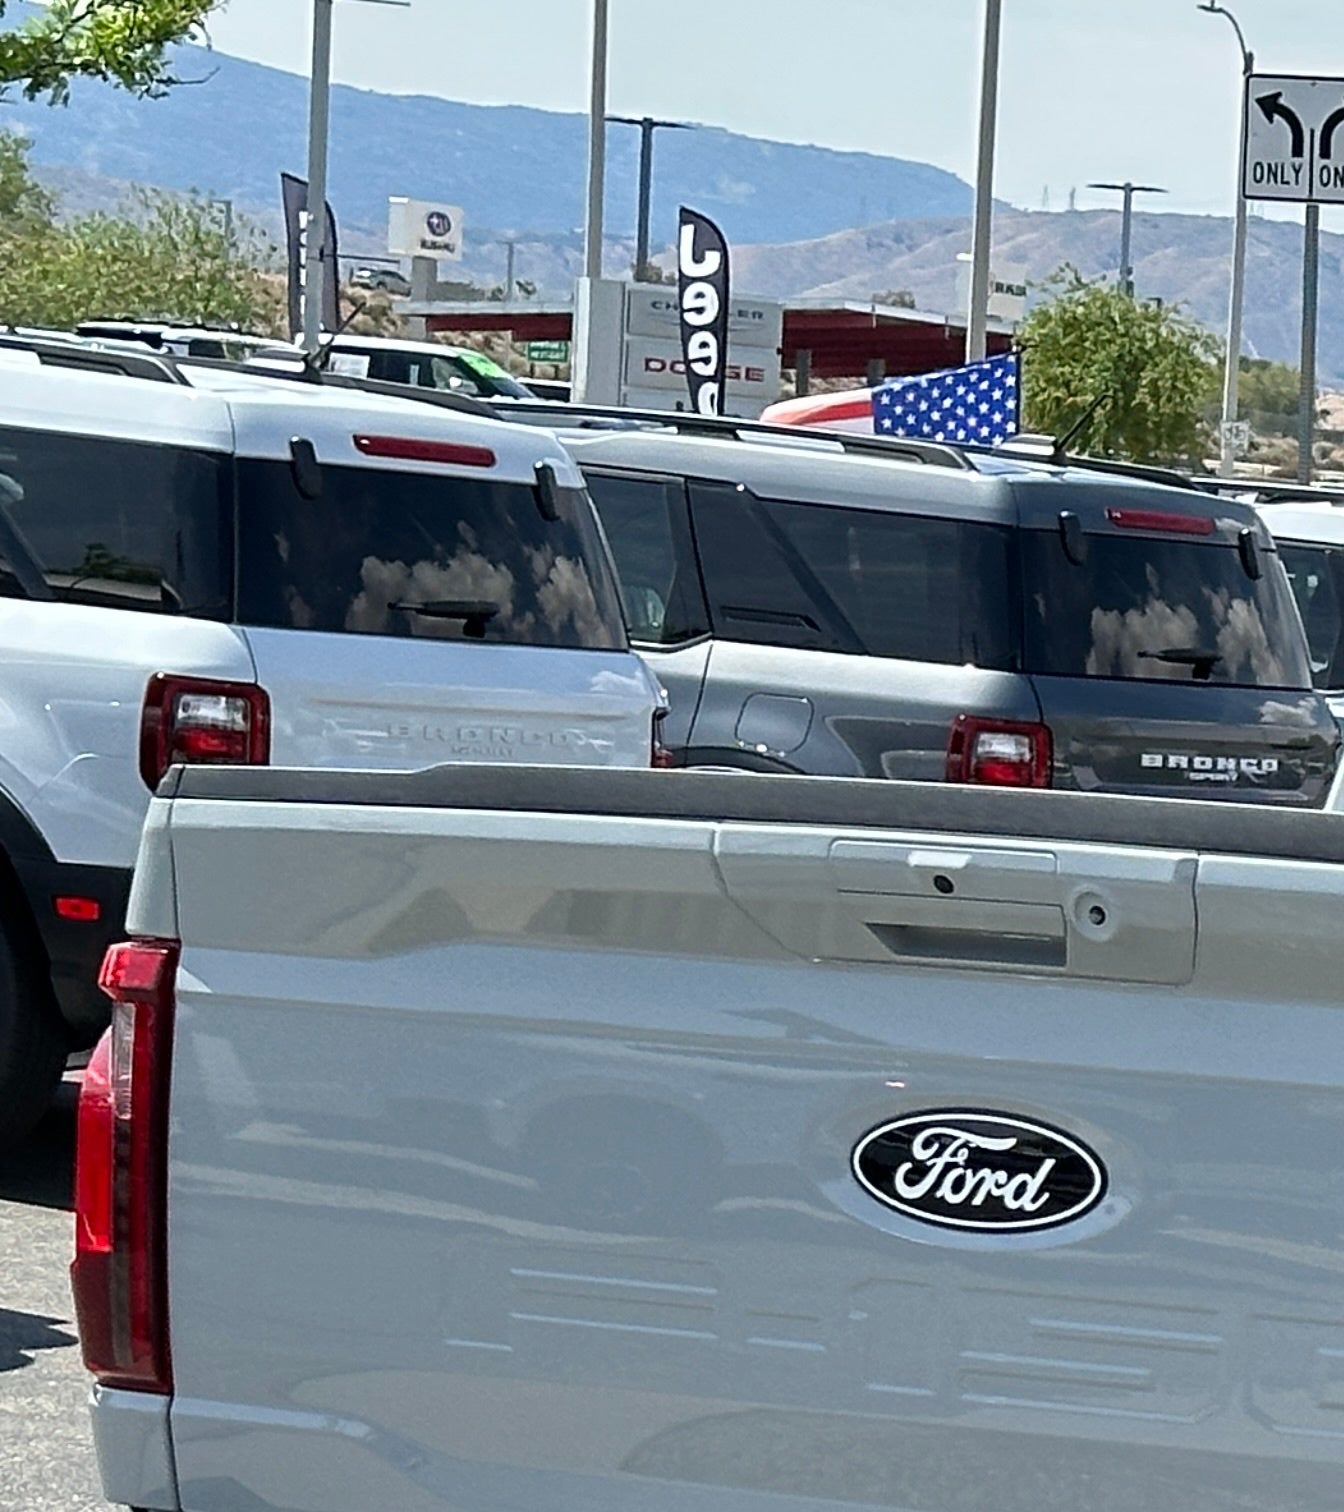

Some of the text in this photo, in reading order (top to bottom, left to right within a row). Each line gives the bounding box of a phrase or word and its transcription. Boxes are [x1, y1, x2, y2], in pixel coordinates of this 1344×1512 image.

[1253, 162, 1303, 186] ONLY
[644, 358, 765, 382] DOGE
[1141, 753, 1279, 772] BRONCO
[1189, 770, 1239, 782] SPORT
[895, 1126, 1057, 1212] Ford
